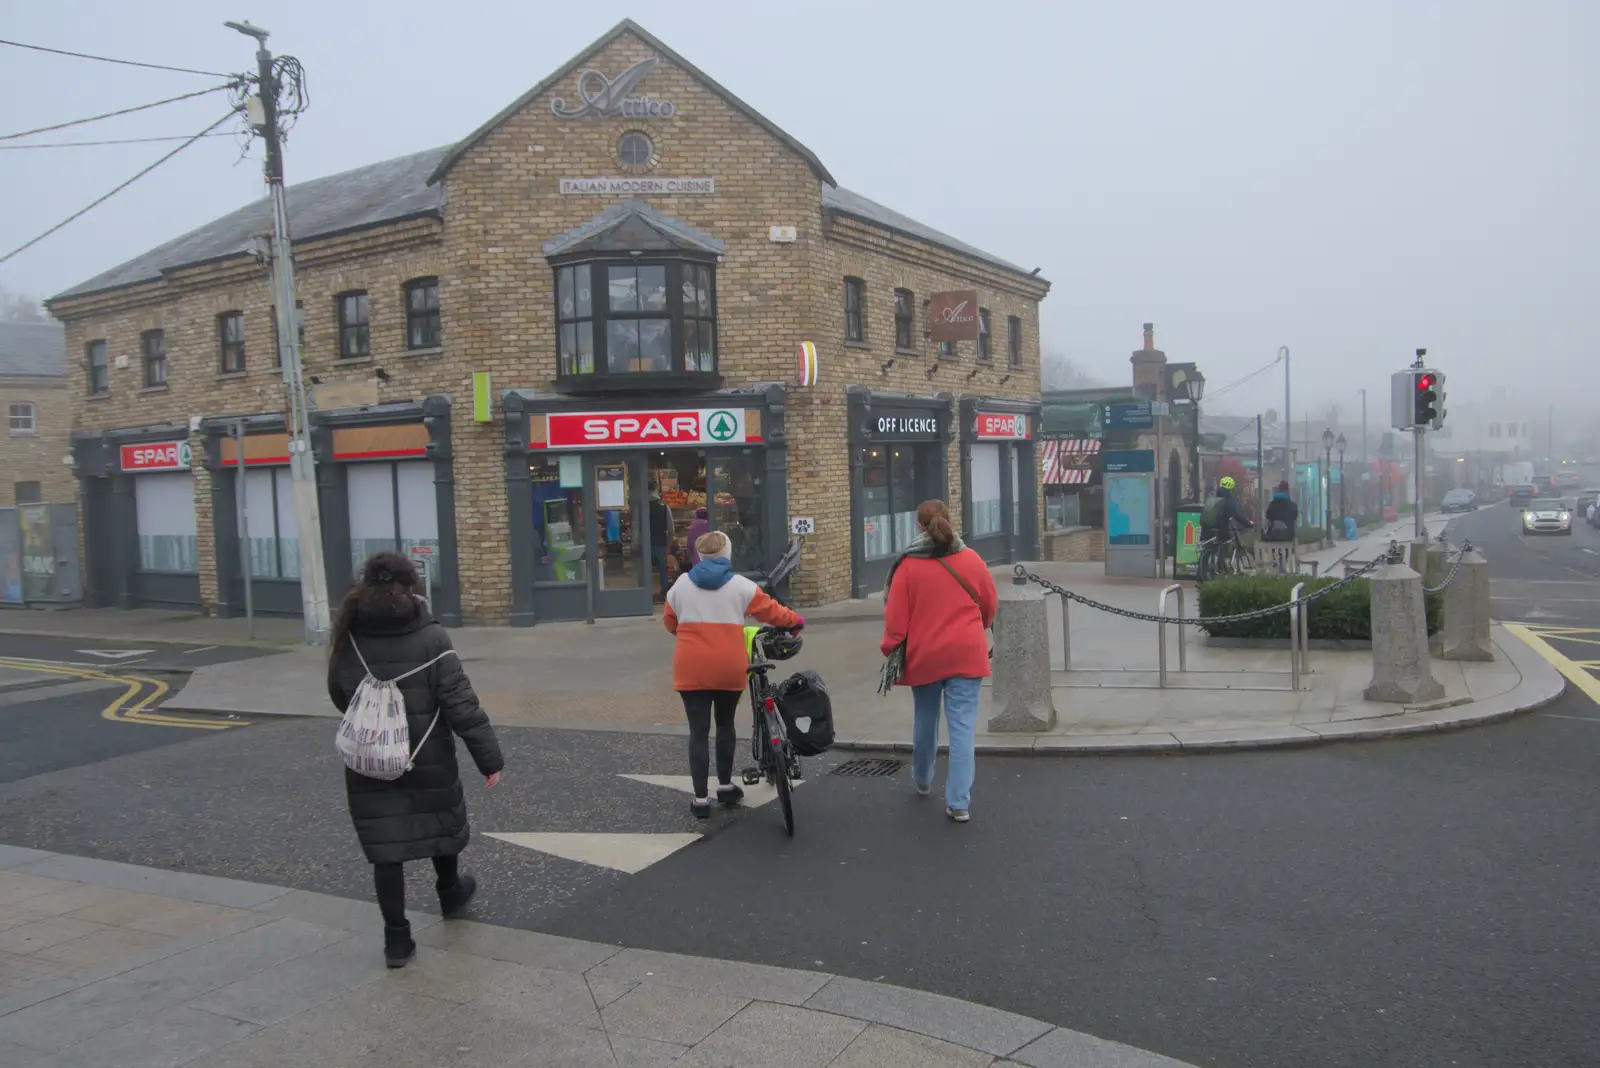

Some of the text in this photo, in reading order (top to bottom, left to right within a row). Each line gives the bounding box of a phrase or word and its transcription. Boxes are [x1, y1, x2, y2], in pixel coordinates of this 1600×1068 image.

[563, 180, 711, 193] ITALIAN MODERN CUISINE
[583, 416, 698, 440] SPAR
[878, 417, 937, 433] OFF LICENCE
[985, 417, 1016, 433] SPAR
[133, 447, 178, 465] SPAR
